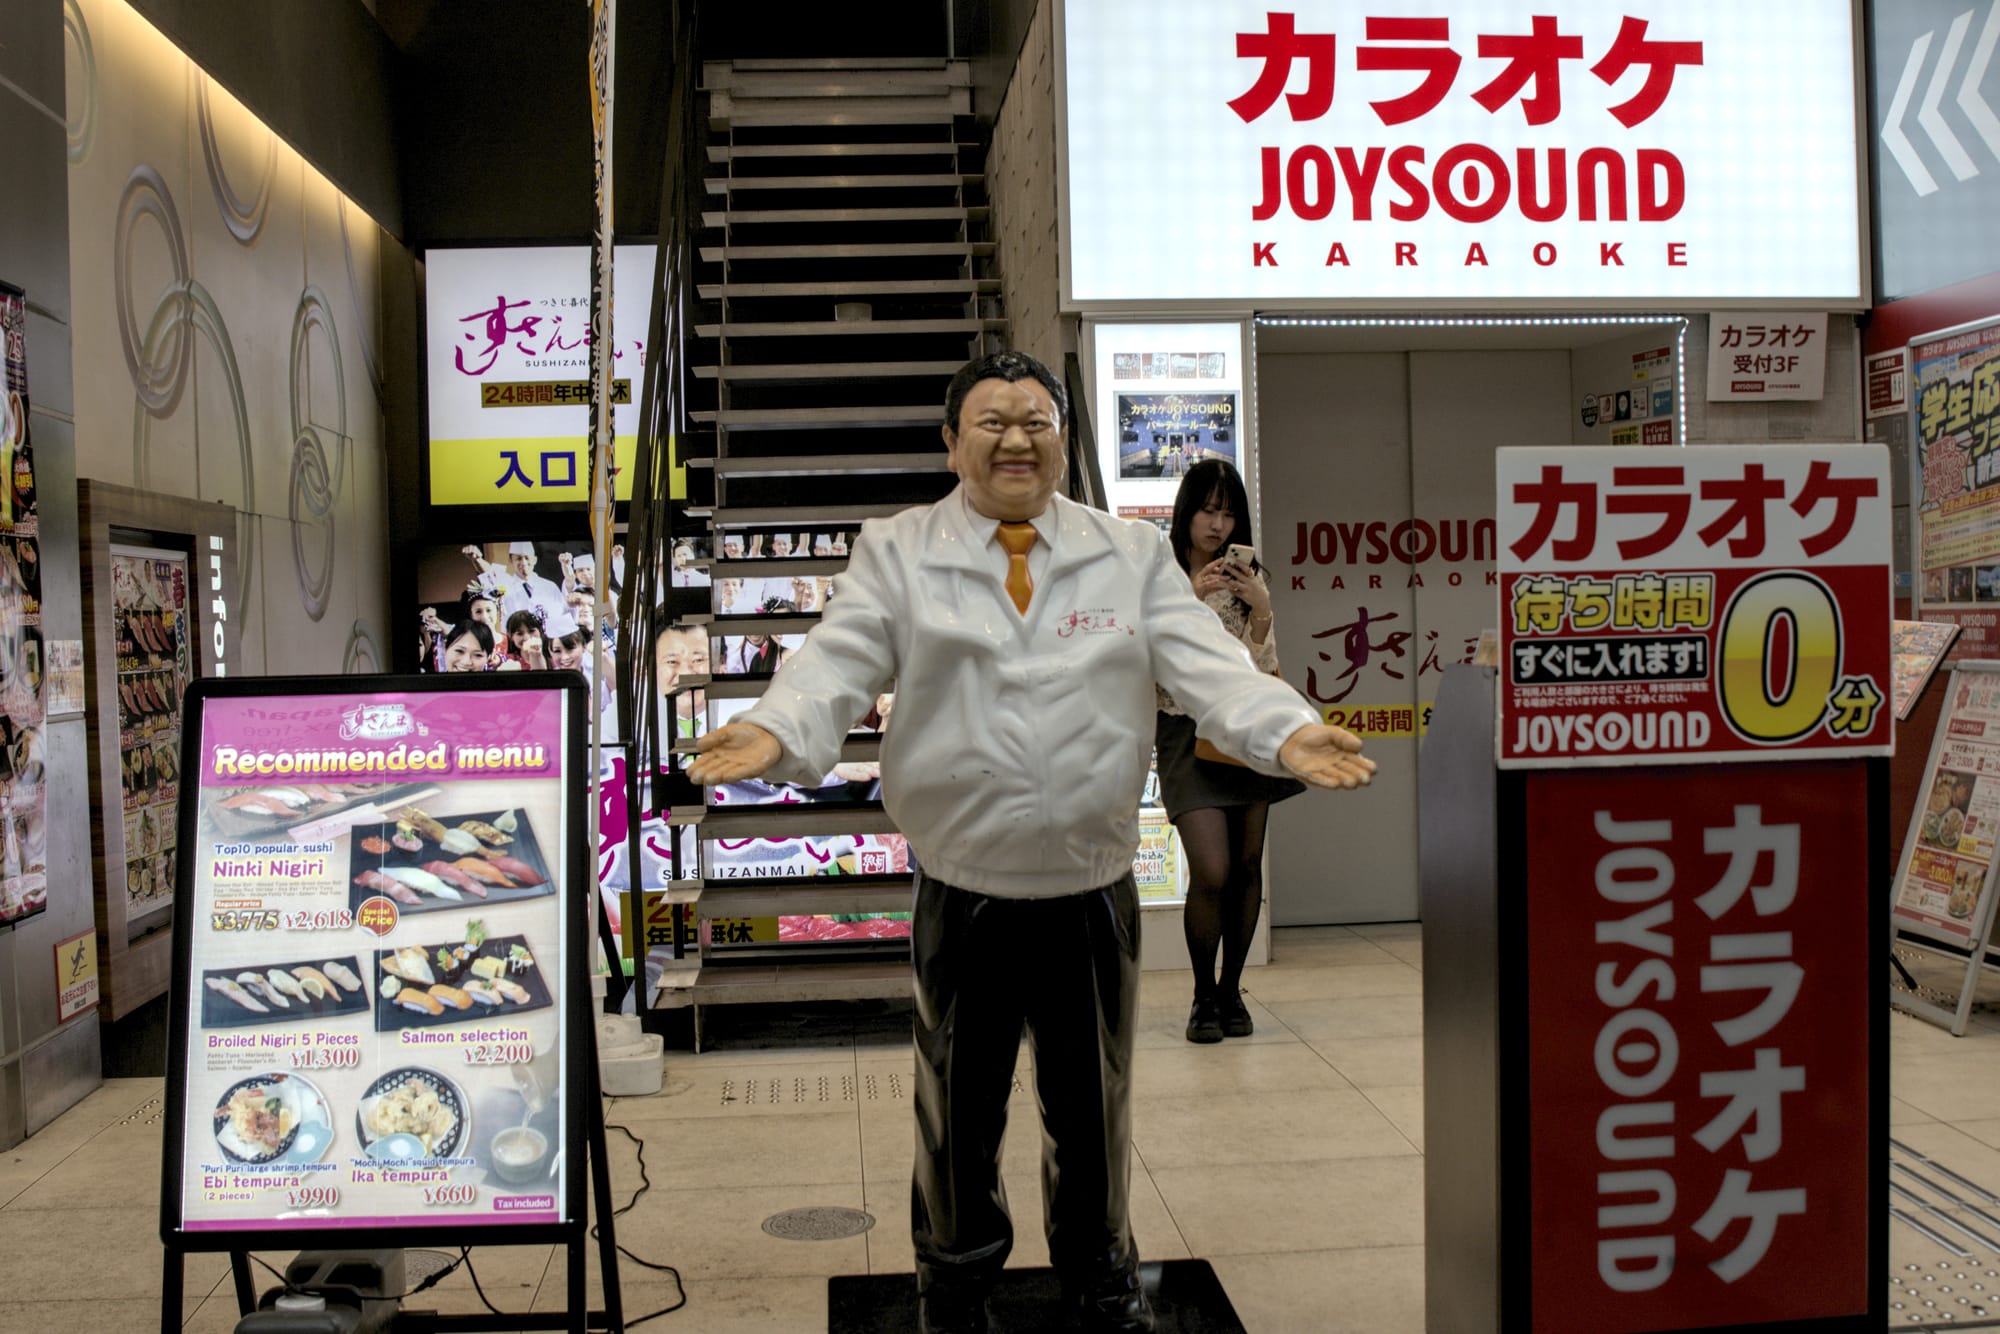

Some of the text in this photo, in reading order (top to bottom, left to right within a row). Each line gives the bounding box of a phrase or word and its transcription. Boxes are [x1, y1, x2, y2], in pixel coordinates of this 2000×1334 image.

[1226, 12, 1704, 129] カラオケ
[1252, 143, 1686, 223] JOYSOUND
[1253, 242, 1688, 267] KARAOKE
[540, 297, 590, 308] つきじ喜代
[1720, 325, 1816, 348] カラオケ
[525, 360, 591, 368] SUSHIZAN
[1733, 355, 1799, 374] 受付3F
[495, 451, 577, 488] 入口
[1509, 461, 1878, 562] カラオケ
[1515, 575, 1713, 632] 待ち時間
[1513, 712, 1710, 753] JOYSOUND
[214, 743, 545, 775] Recommended menu
[215, 842, 333, 855] Top10 popular sushi
[213, 859, 324, 877] Ninki Nigiri
[213, 911, 351, 930] ¥3,775 ¥2,618
[363, 916, 393, 926] Price
[208, 1033, 359, 1048] Broiled Nigiri 5 Pieces
[402, 1029, 528, 1043] Salmon selection
[1690, 805, 1807, 1284] カラオケ
[291, 1049, 358, 1067] ¥1,300
[465, 1045, 531, 1063] ¥2,200
[1594, 810, 1680, 1292] JOYSOUND
[247, 1164, 268, 1172] large
[271, 1164, 299, 1172] shrimp
[302, 1163, 337, 1171] tempura
[438, 1157, 475, 1167] tempura
[204, 1176, 299, 1189] Ebi tempura
[352, 1170, 448, 1182] Ika tempura
[204, 1191, 255, 1200] (2 pieces)
[288, 1188, 337, 1206] ¥990
[425, 1184, 474, 1202] ¥660
[497, 1198, 550, 1208] Tax included
